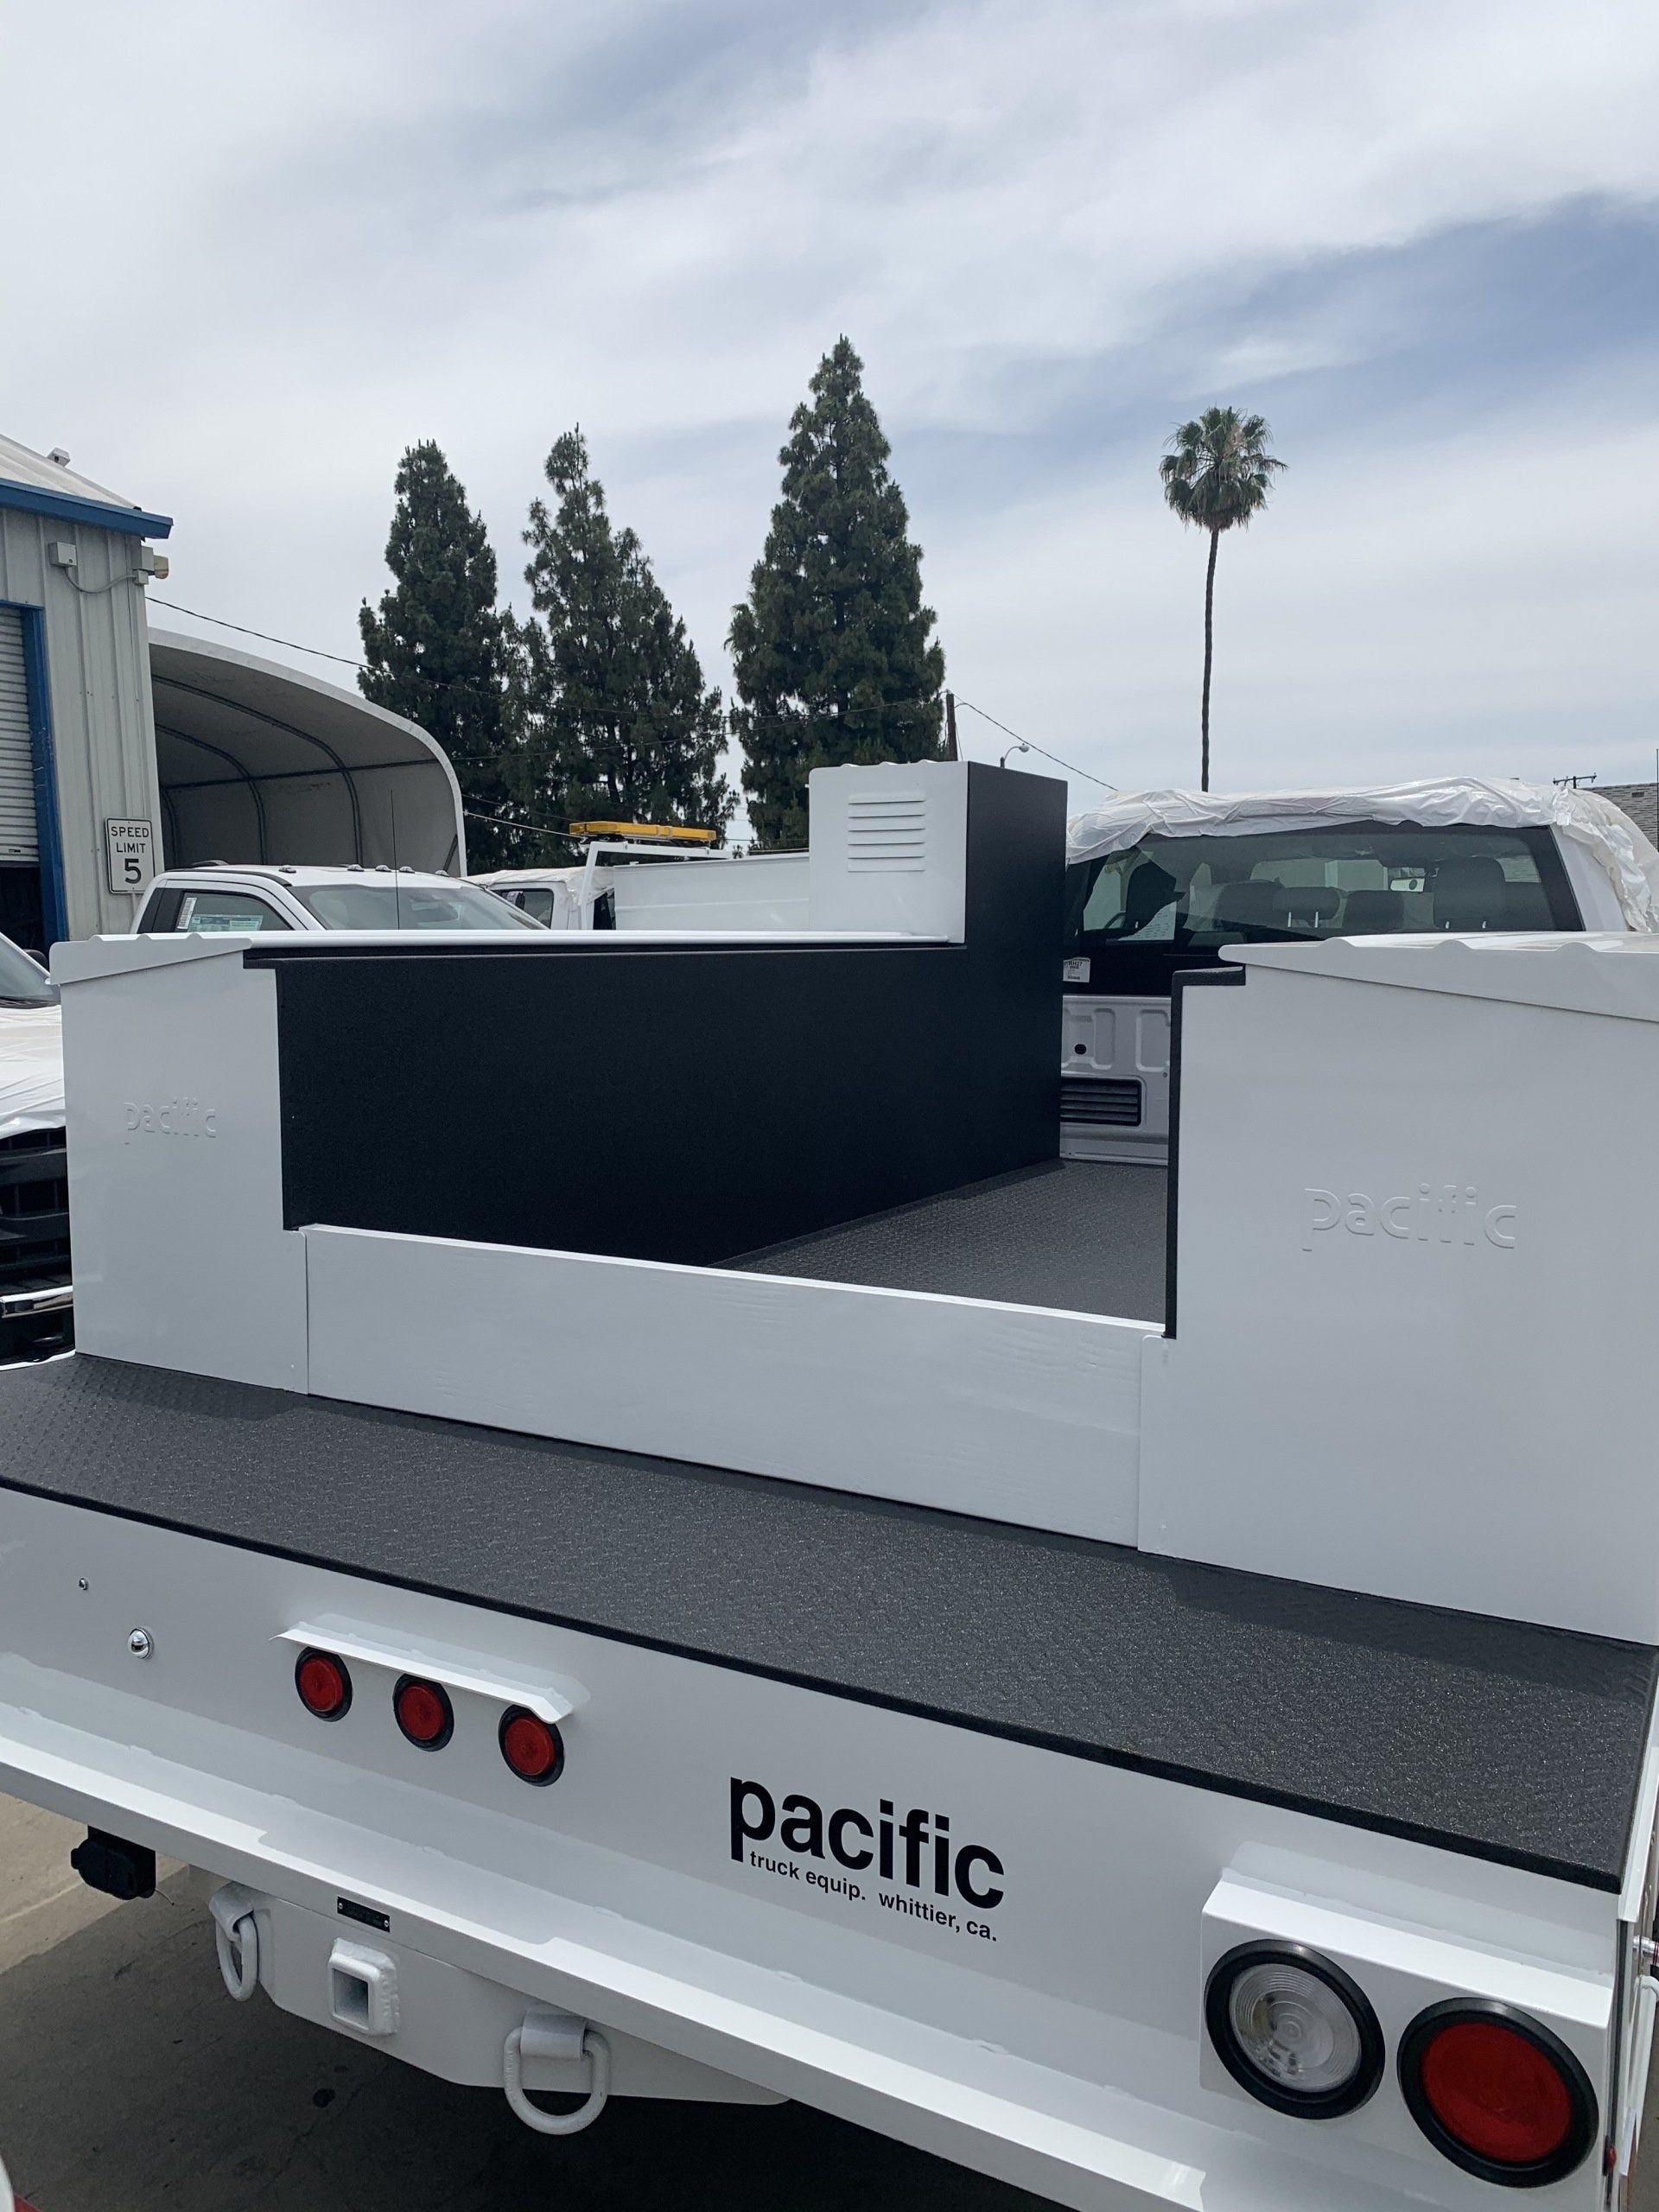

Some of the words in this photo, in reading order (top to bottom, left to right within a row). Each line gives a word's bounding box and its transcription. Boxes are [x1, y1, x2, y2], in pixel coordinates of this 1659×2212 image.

[111, 826, 149, 838] SPEED
[116, 842, 146, 854] LIMIT
[124, 858, 142, 884] 5
[124, 1096, 217, 1145] pacific
[1302, 1183, 1517, 1251] pacific
[730, 1777, 1005, 1910] pacific
[749, 1851, 800, 1881] truck
[805, 1869, 866, 1902] equip.
[879, 1892, 961, 1934] whittier,
[966, 1920, 997, 1942] ca.
